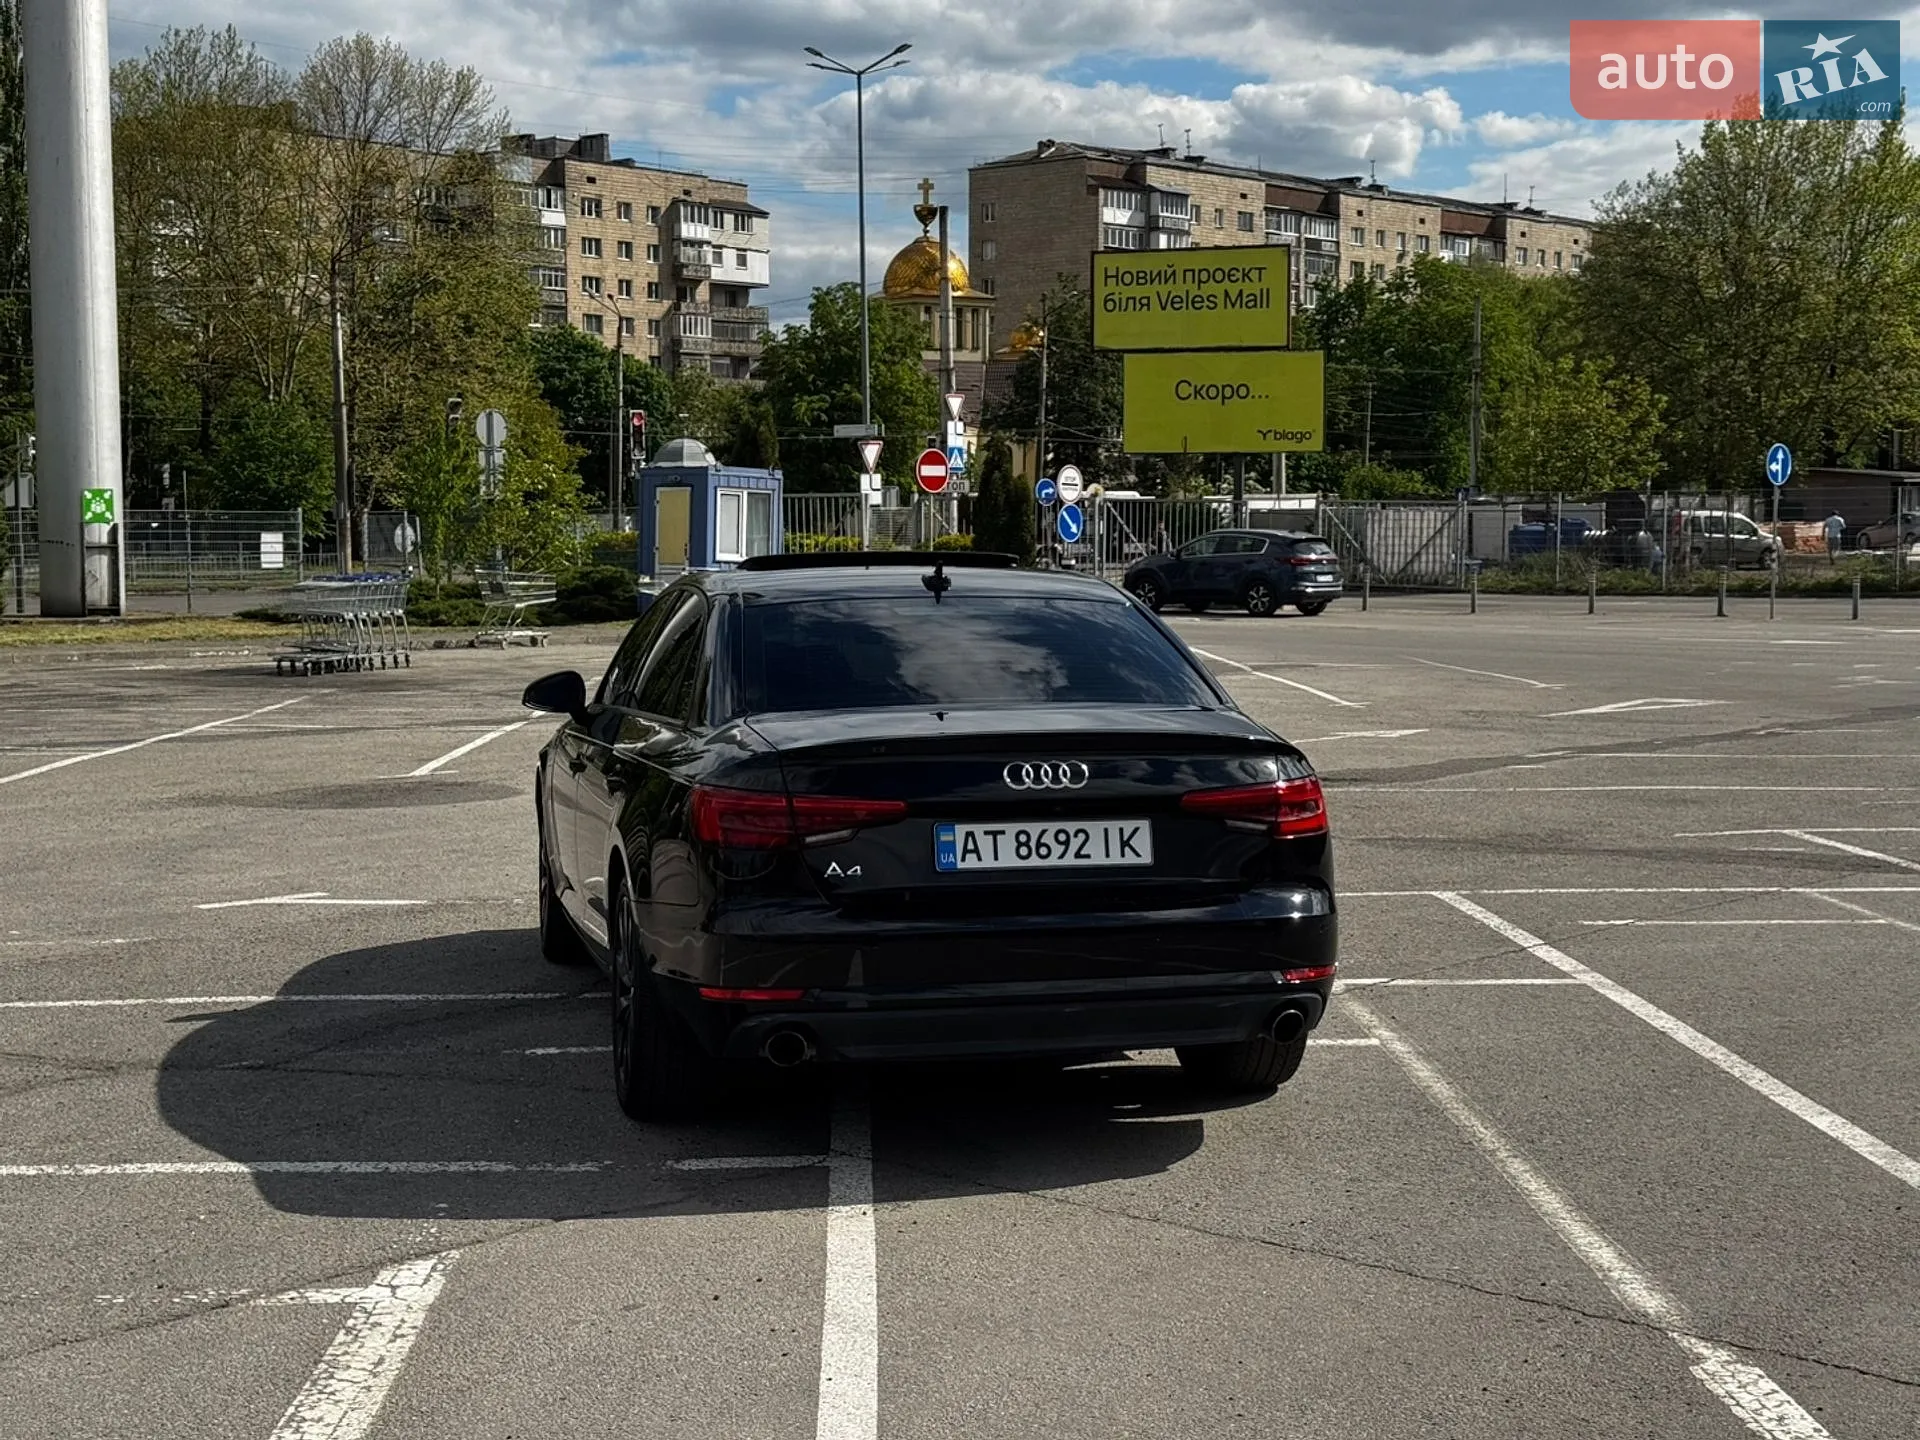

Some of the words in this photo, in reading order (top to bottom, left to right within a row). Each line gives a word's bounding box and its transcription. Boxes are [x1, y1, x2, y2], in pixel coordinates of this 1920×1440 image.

[1103, 264, 1176, 287] Новий
[1183, 266, 1267, 290] проєкт
[1103, 292, 1151, 312] біля
[1156, 290, 1218, 311] Veles
[1223, 288, 1270, 309] Mall
[960, 829, 1006, 863] AT
[1014, 828, 1091, 860] 8692
[1103, 827, 1142, 859] IK
[824, 861, 862, 878] A4
[940, 853, 956, 864] UA
